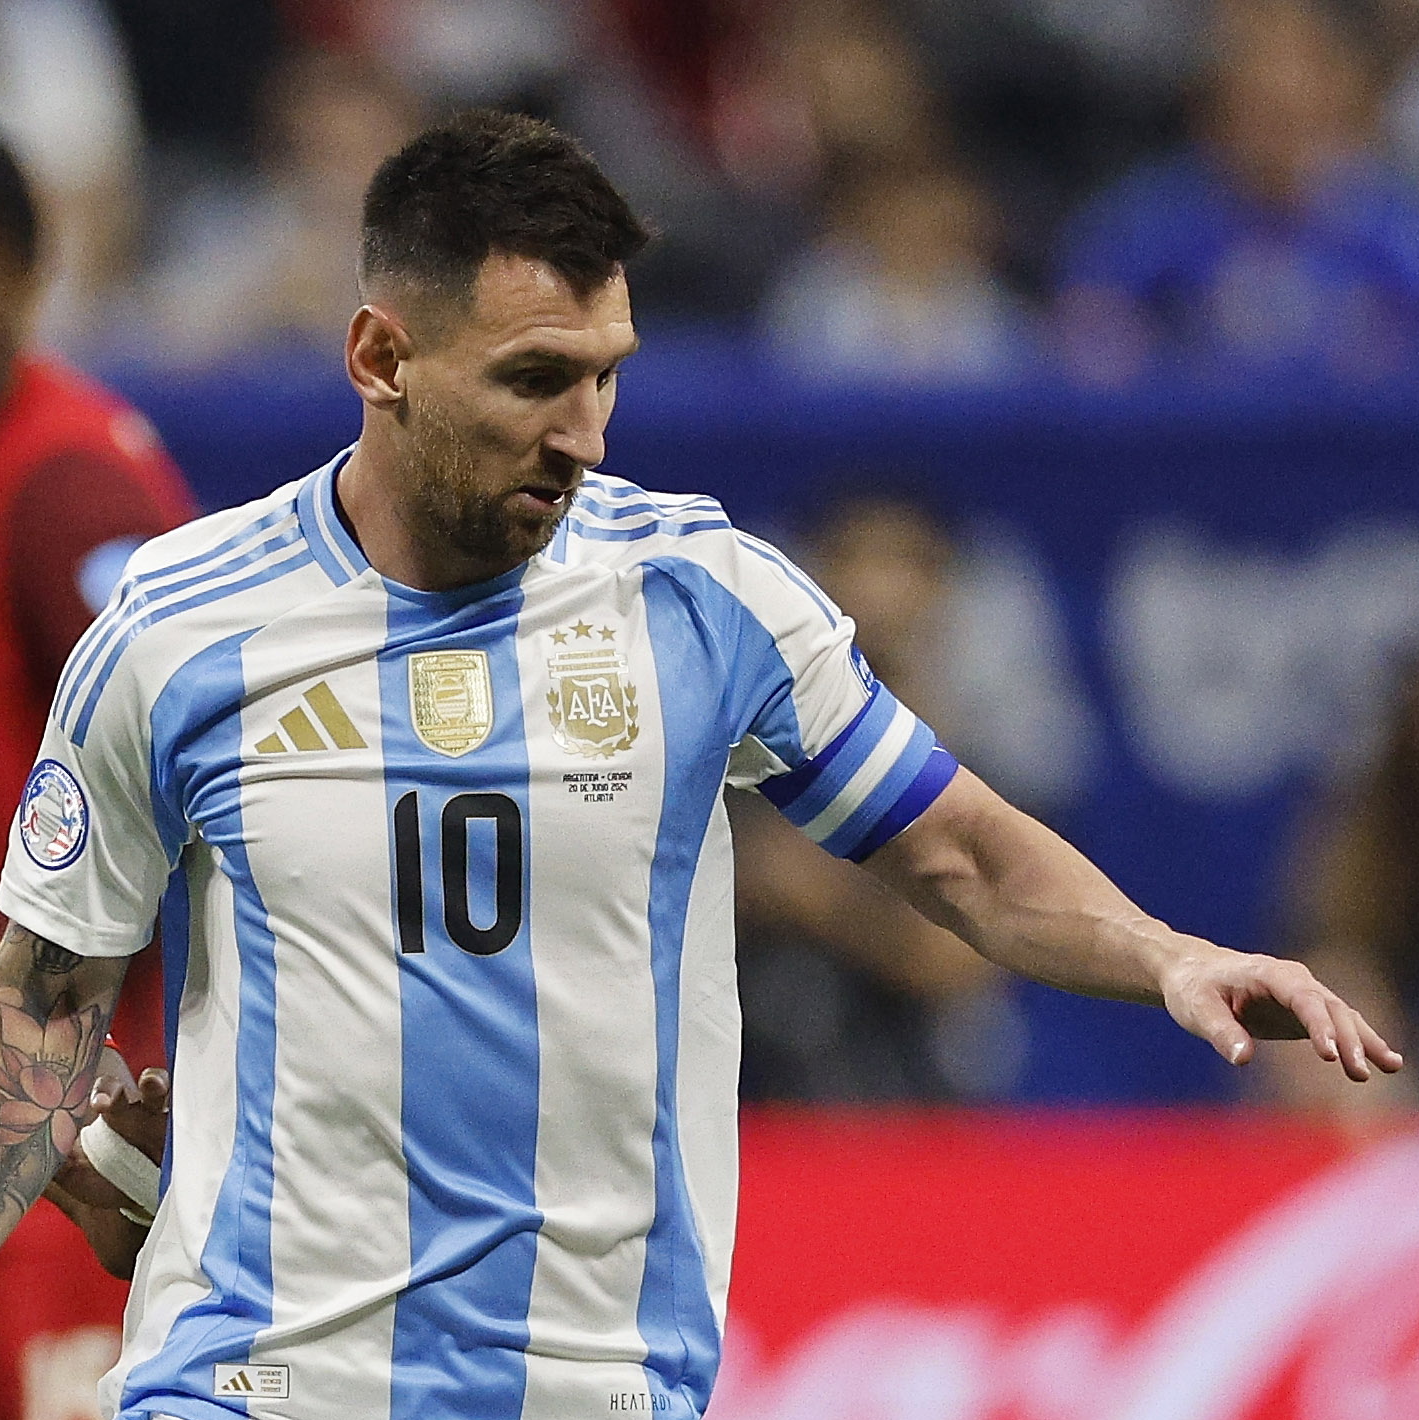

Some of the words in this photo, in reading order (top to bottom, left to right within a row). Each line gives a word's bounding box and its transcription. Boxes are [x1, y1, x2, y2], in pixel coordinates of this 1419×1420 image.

[568, 677, 620, 727] AFA
[568, 783, 578, 792] 20
[583, 793, 614, 802] ATLANTA
[393, 790, 523, 957] 10
